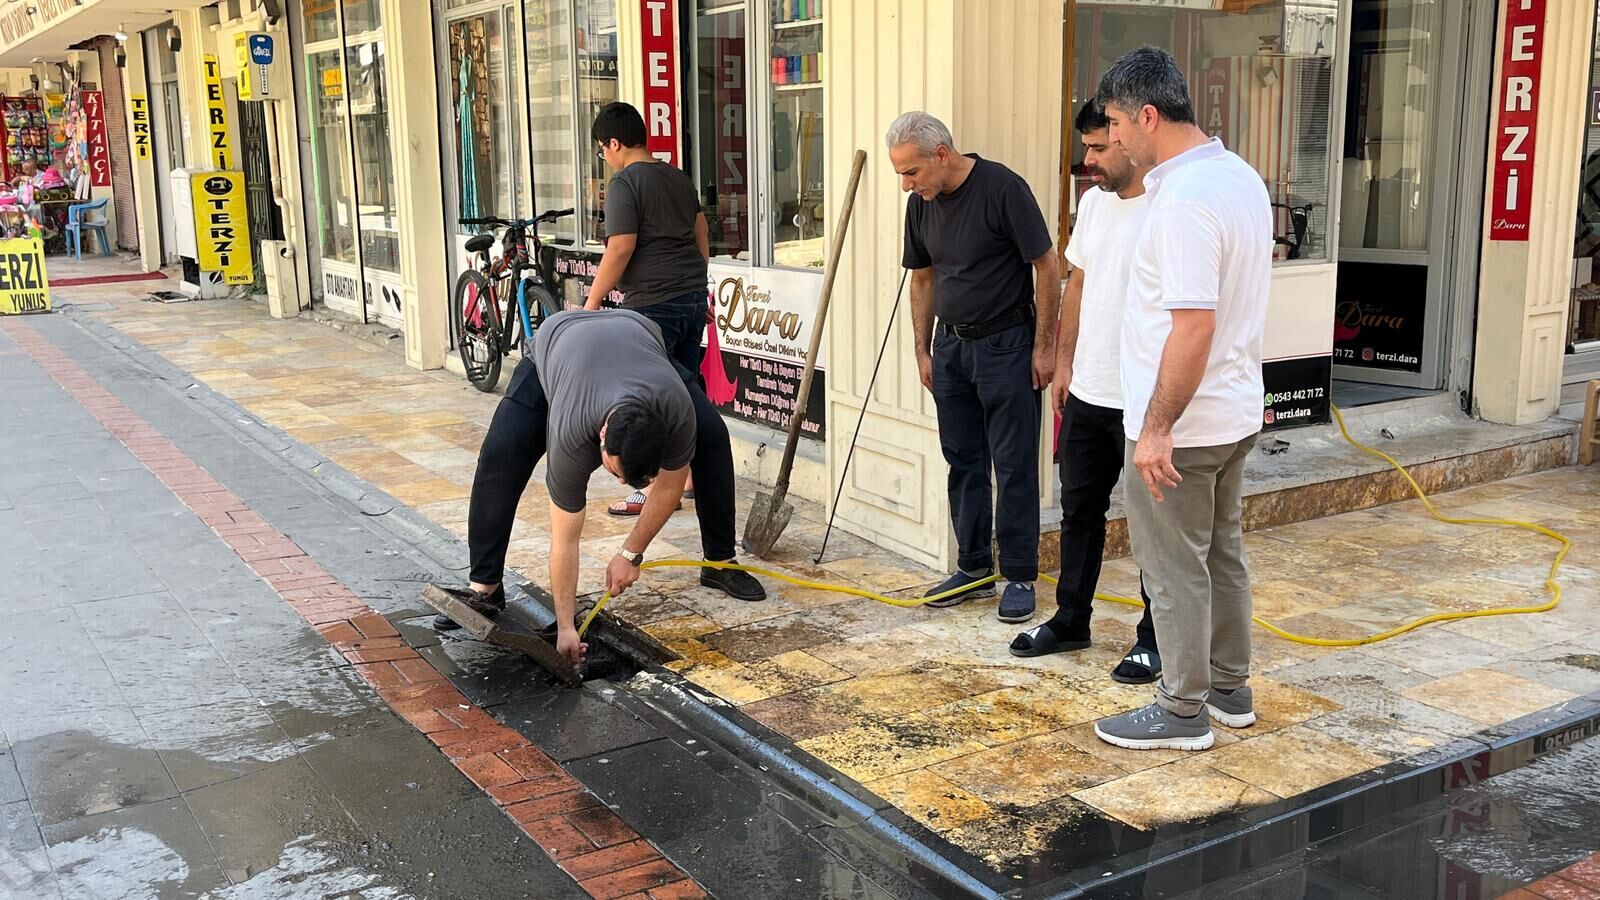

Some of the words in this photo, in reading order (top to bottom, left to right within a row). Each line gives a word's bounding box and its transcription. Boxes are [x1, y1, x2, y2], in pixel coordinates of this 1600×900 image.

[1501, 0, 1536, 210] ERZİ
[204, 61, 227, 170] TERZİ
[87, 92, 107, 184] KİTAPÇI
[131, 99, 149, 157] TERZİ
[208, 198, 235, 266] TERZİ
[1493, 218, 1526, 231] Dara
[556, 257, 568, 273] Her
[10, 292, 47, 312] YUNUS
[747, 284, 771, 304] Terzi
[717, 277, 803, 342] Dara
[725, 334, 742, 348] Bayan
[764, 339, 778, 353] Özel
[1344, 349, 1354, 358] 72
[1376, 352, 1418, 364] terzi.dara
[1273, 391, 1291, 403] 0543
[1292, 389, 1305, 400] 442
[1307, 388, 1313, 398] 71
[1315, 387, 1324, 398] 72
[1276, 408, 1311, 420] terzi.dara
